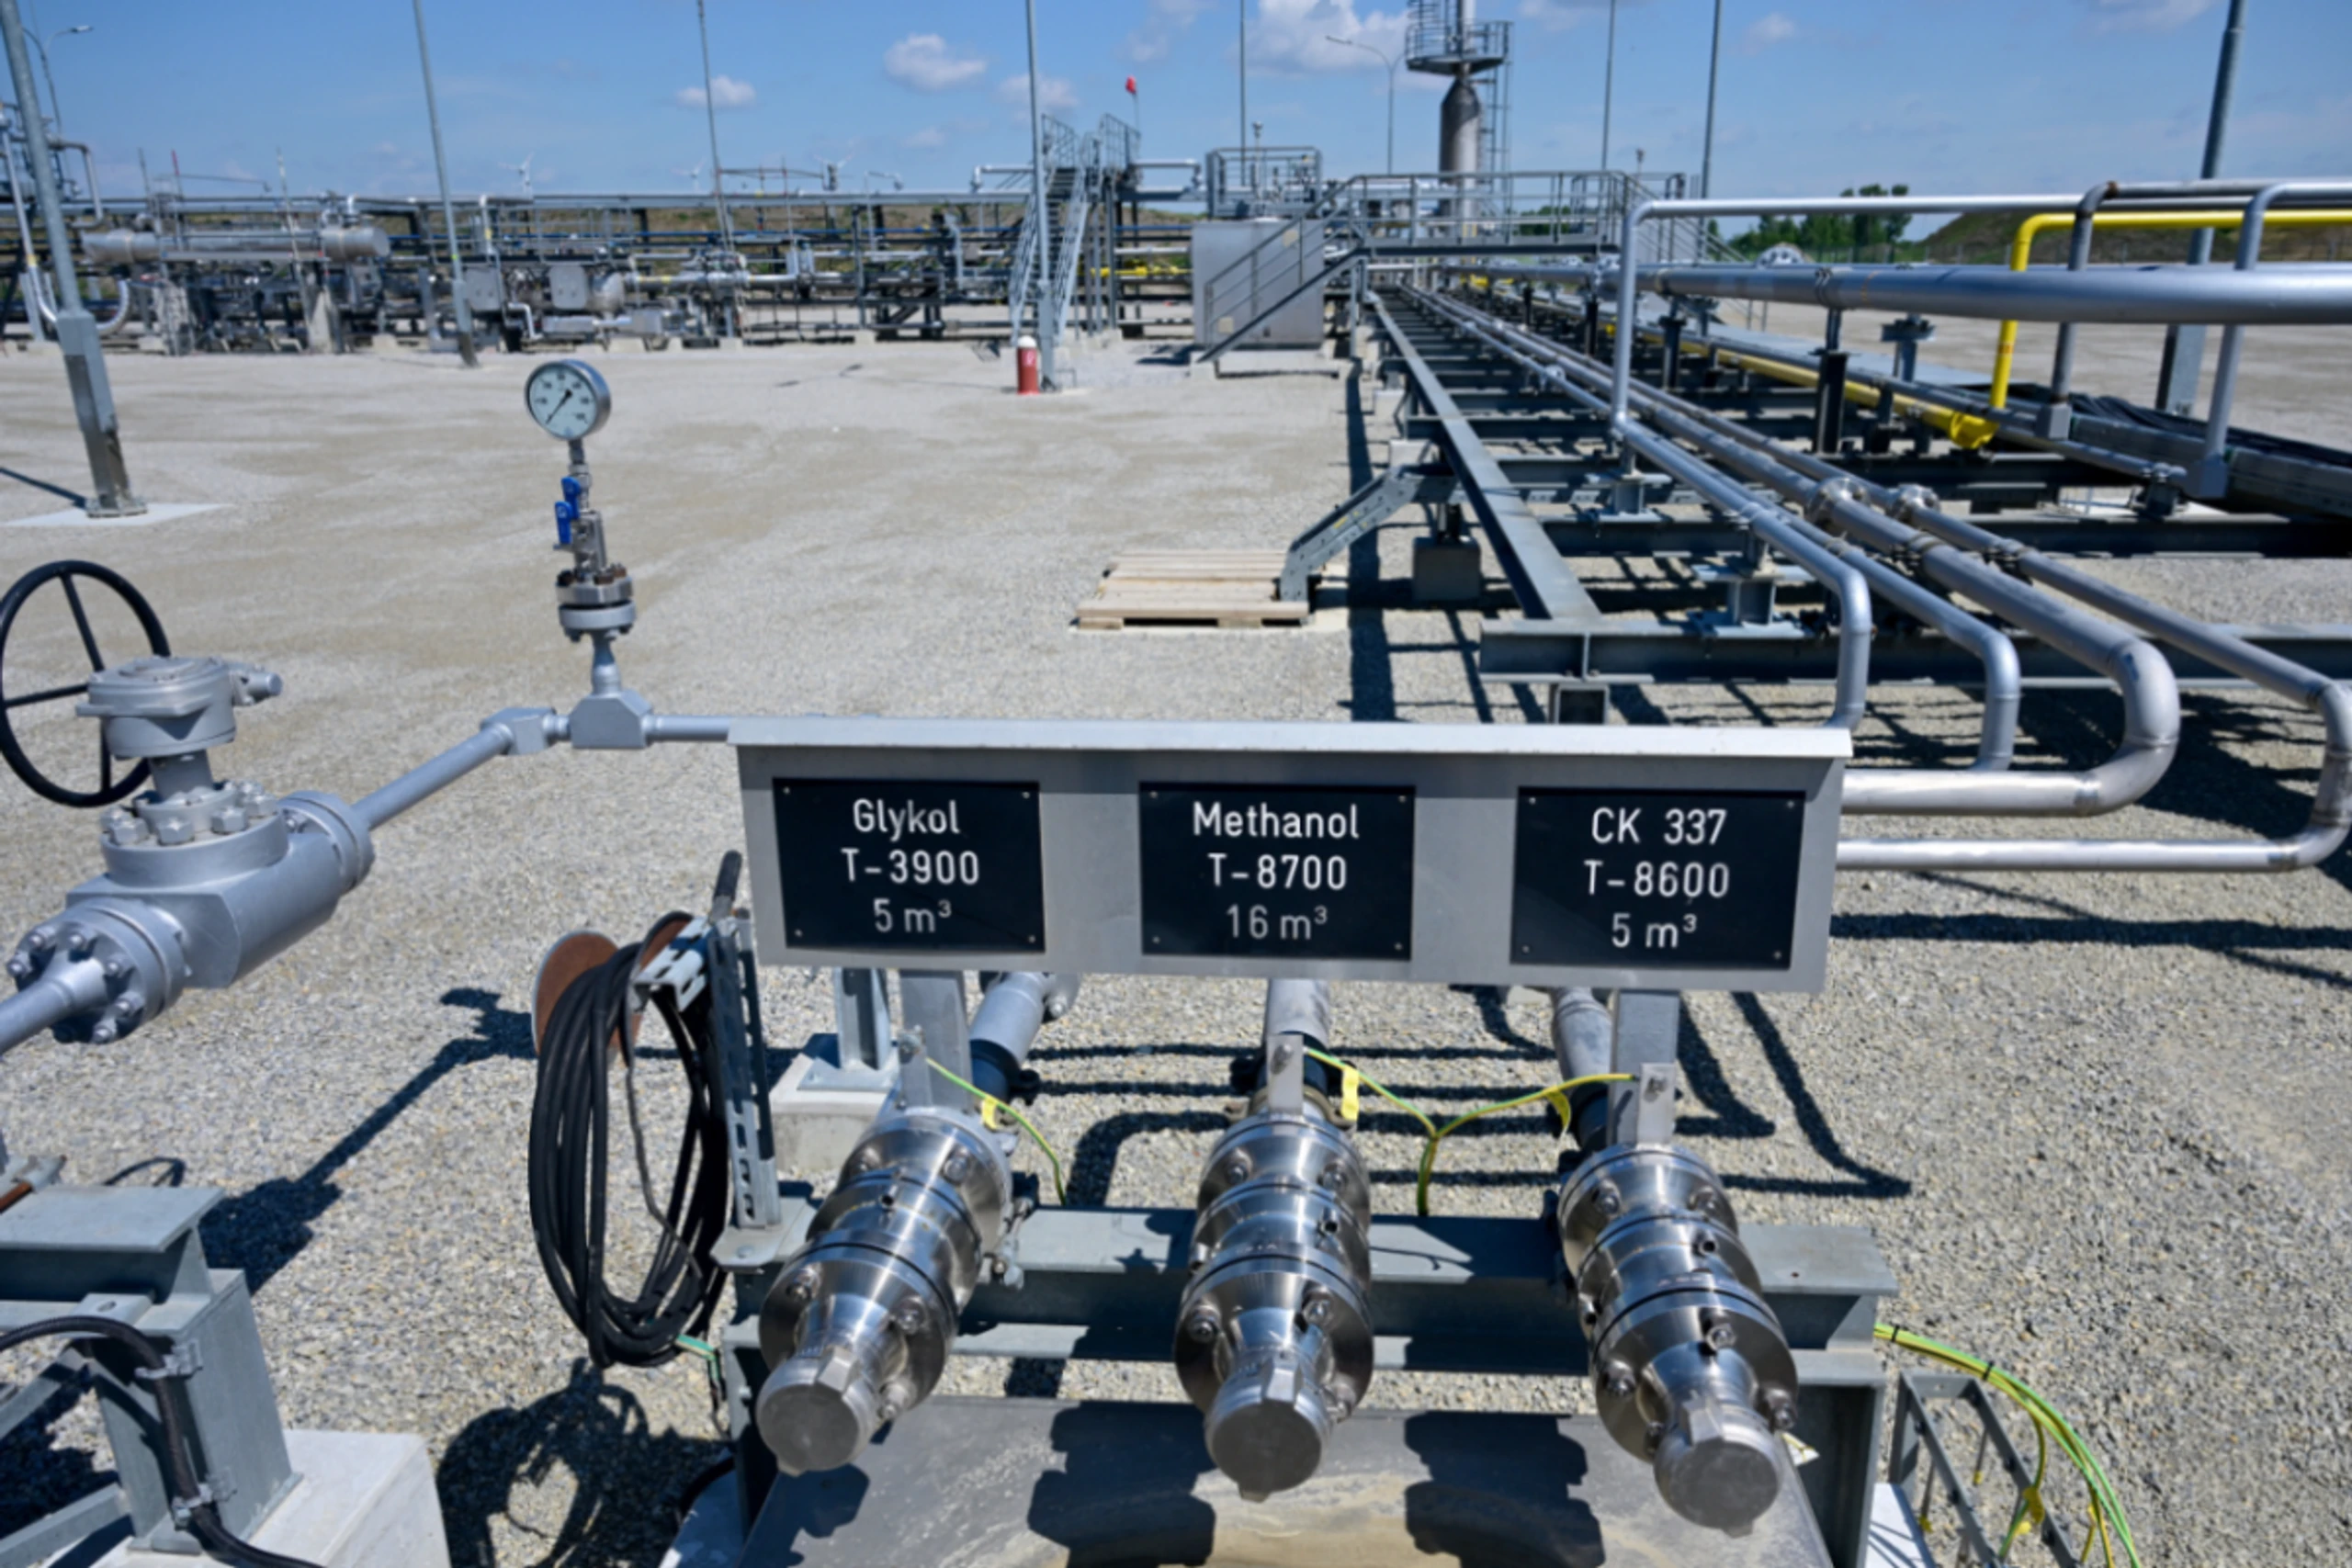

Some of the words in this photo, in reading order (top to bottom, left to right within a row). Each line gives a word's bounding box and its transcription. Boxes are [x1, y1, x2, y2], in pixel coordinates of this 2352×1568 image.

[851, 798, 961, 841] Glykol
[1192, 801, 1361, 840] Methanol
[1590, 807, 1641, 844] CK
[1662, 807, 1727, 845] 337
[840, 847, 980, 886] T-3900
[1206, 852, 1348, 891] T-8700
[1583, 859, 1730, 898] T-8600
[873, 897, 893, 932] 5
[1227, 904, 1269, 940] 16
[1611, 912, 1632, 949] 5
